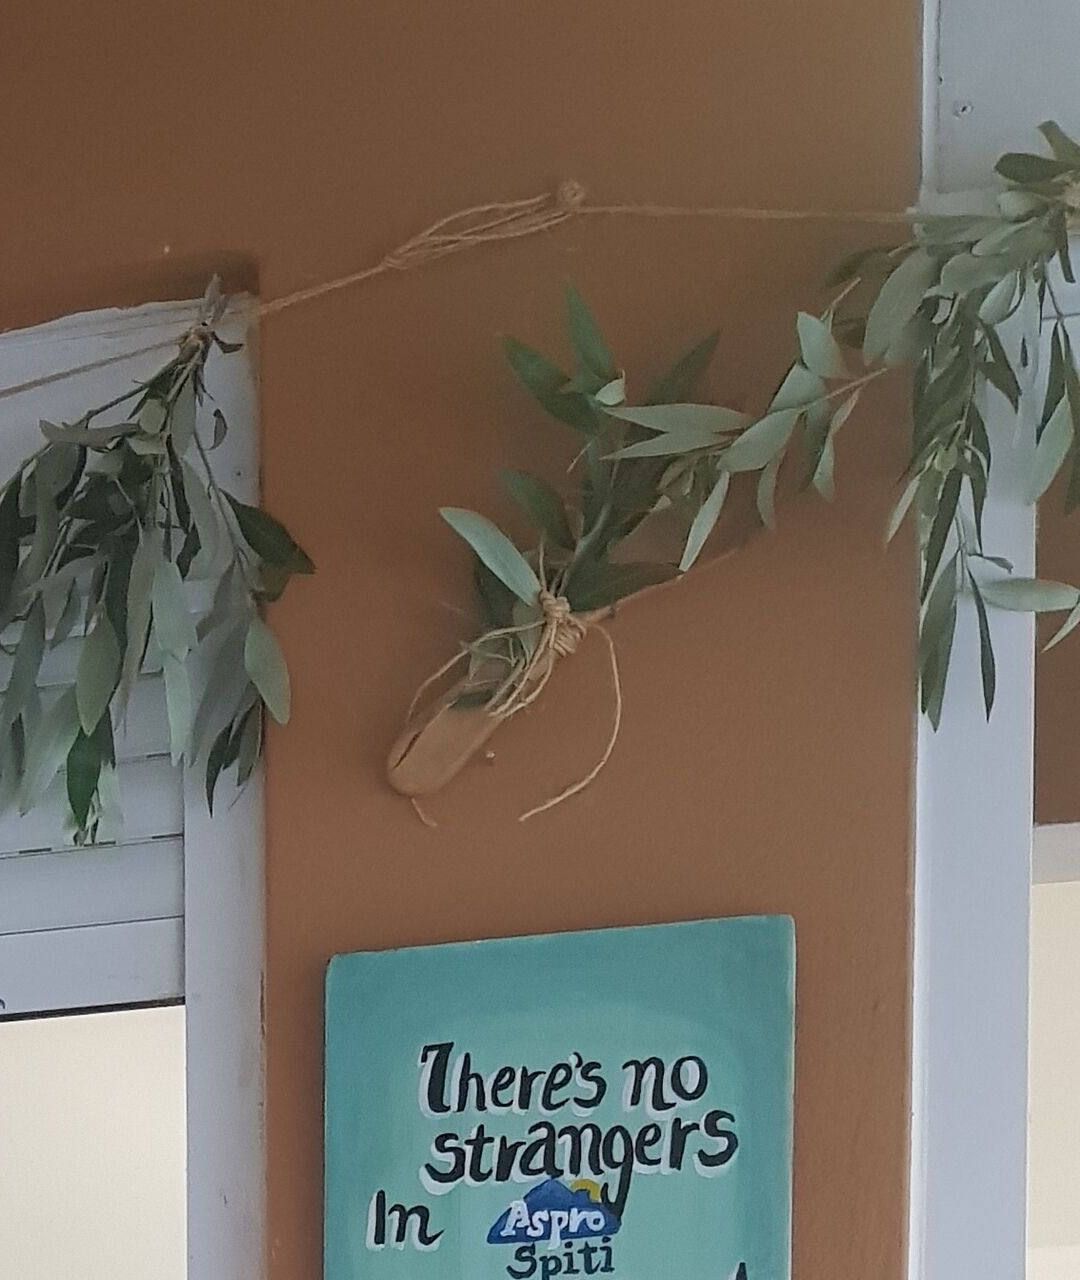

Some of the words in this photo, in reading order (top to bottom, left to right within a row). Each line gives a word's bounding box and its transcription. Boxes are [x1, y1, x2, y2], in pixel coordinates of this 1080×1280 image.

[622, 1054, 708, 1107] no
[424, 1110, 738, 1225] strangers
[372, 1189, 442, 1246] In
[500, 1200, 606, 1246] Aspro
